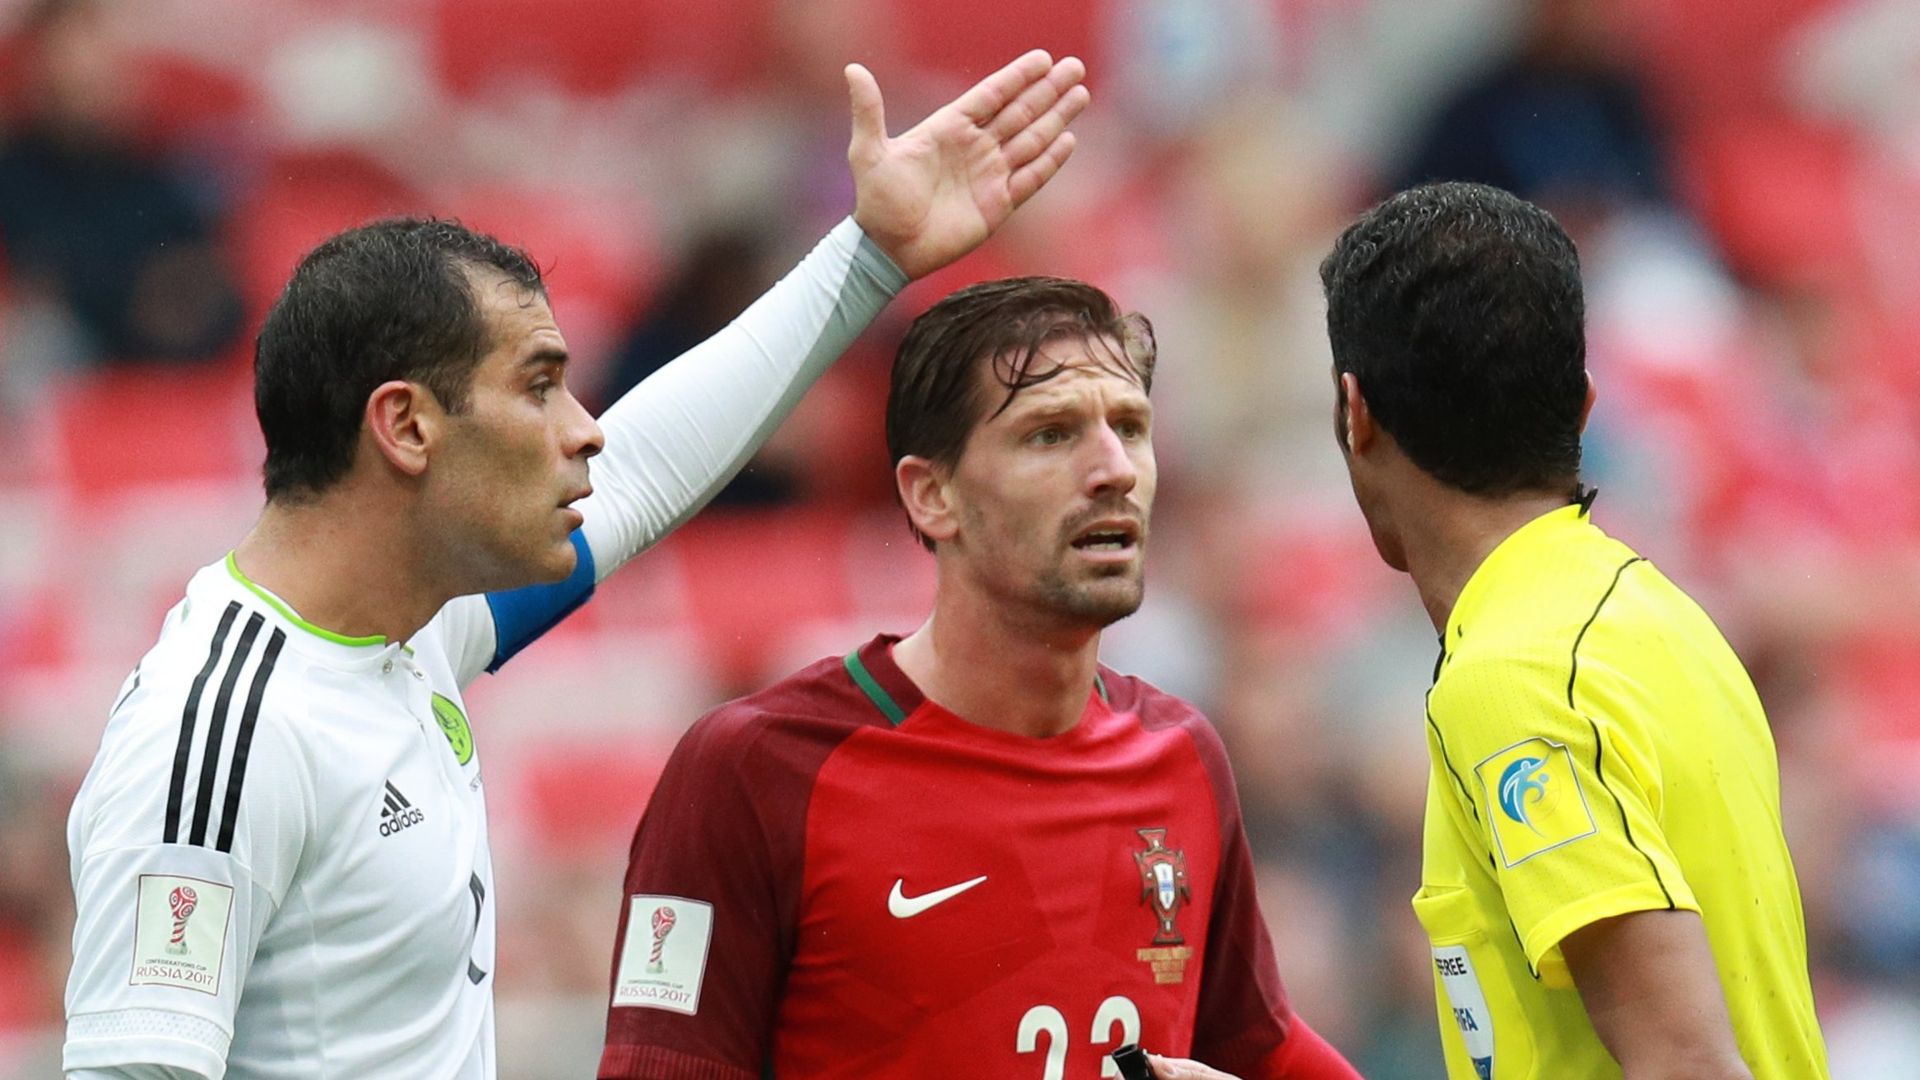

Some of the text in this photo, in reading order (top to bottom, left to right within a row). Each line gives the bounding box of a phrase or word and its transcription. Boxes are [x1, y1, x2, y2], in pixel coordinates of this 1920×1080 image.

[379, 808, 425, 837] adidas
[136, 965, 214, 986] RUSSIA 2017
[620, 986, 691, 1003] RUSSIA 2017
